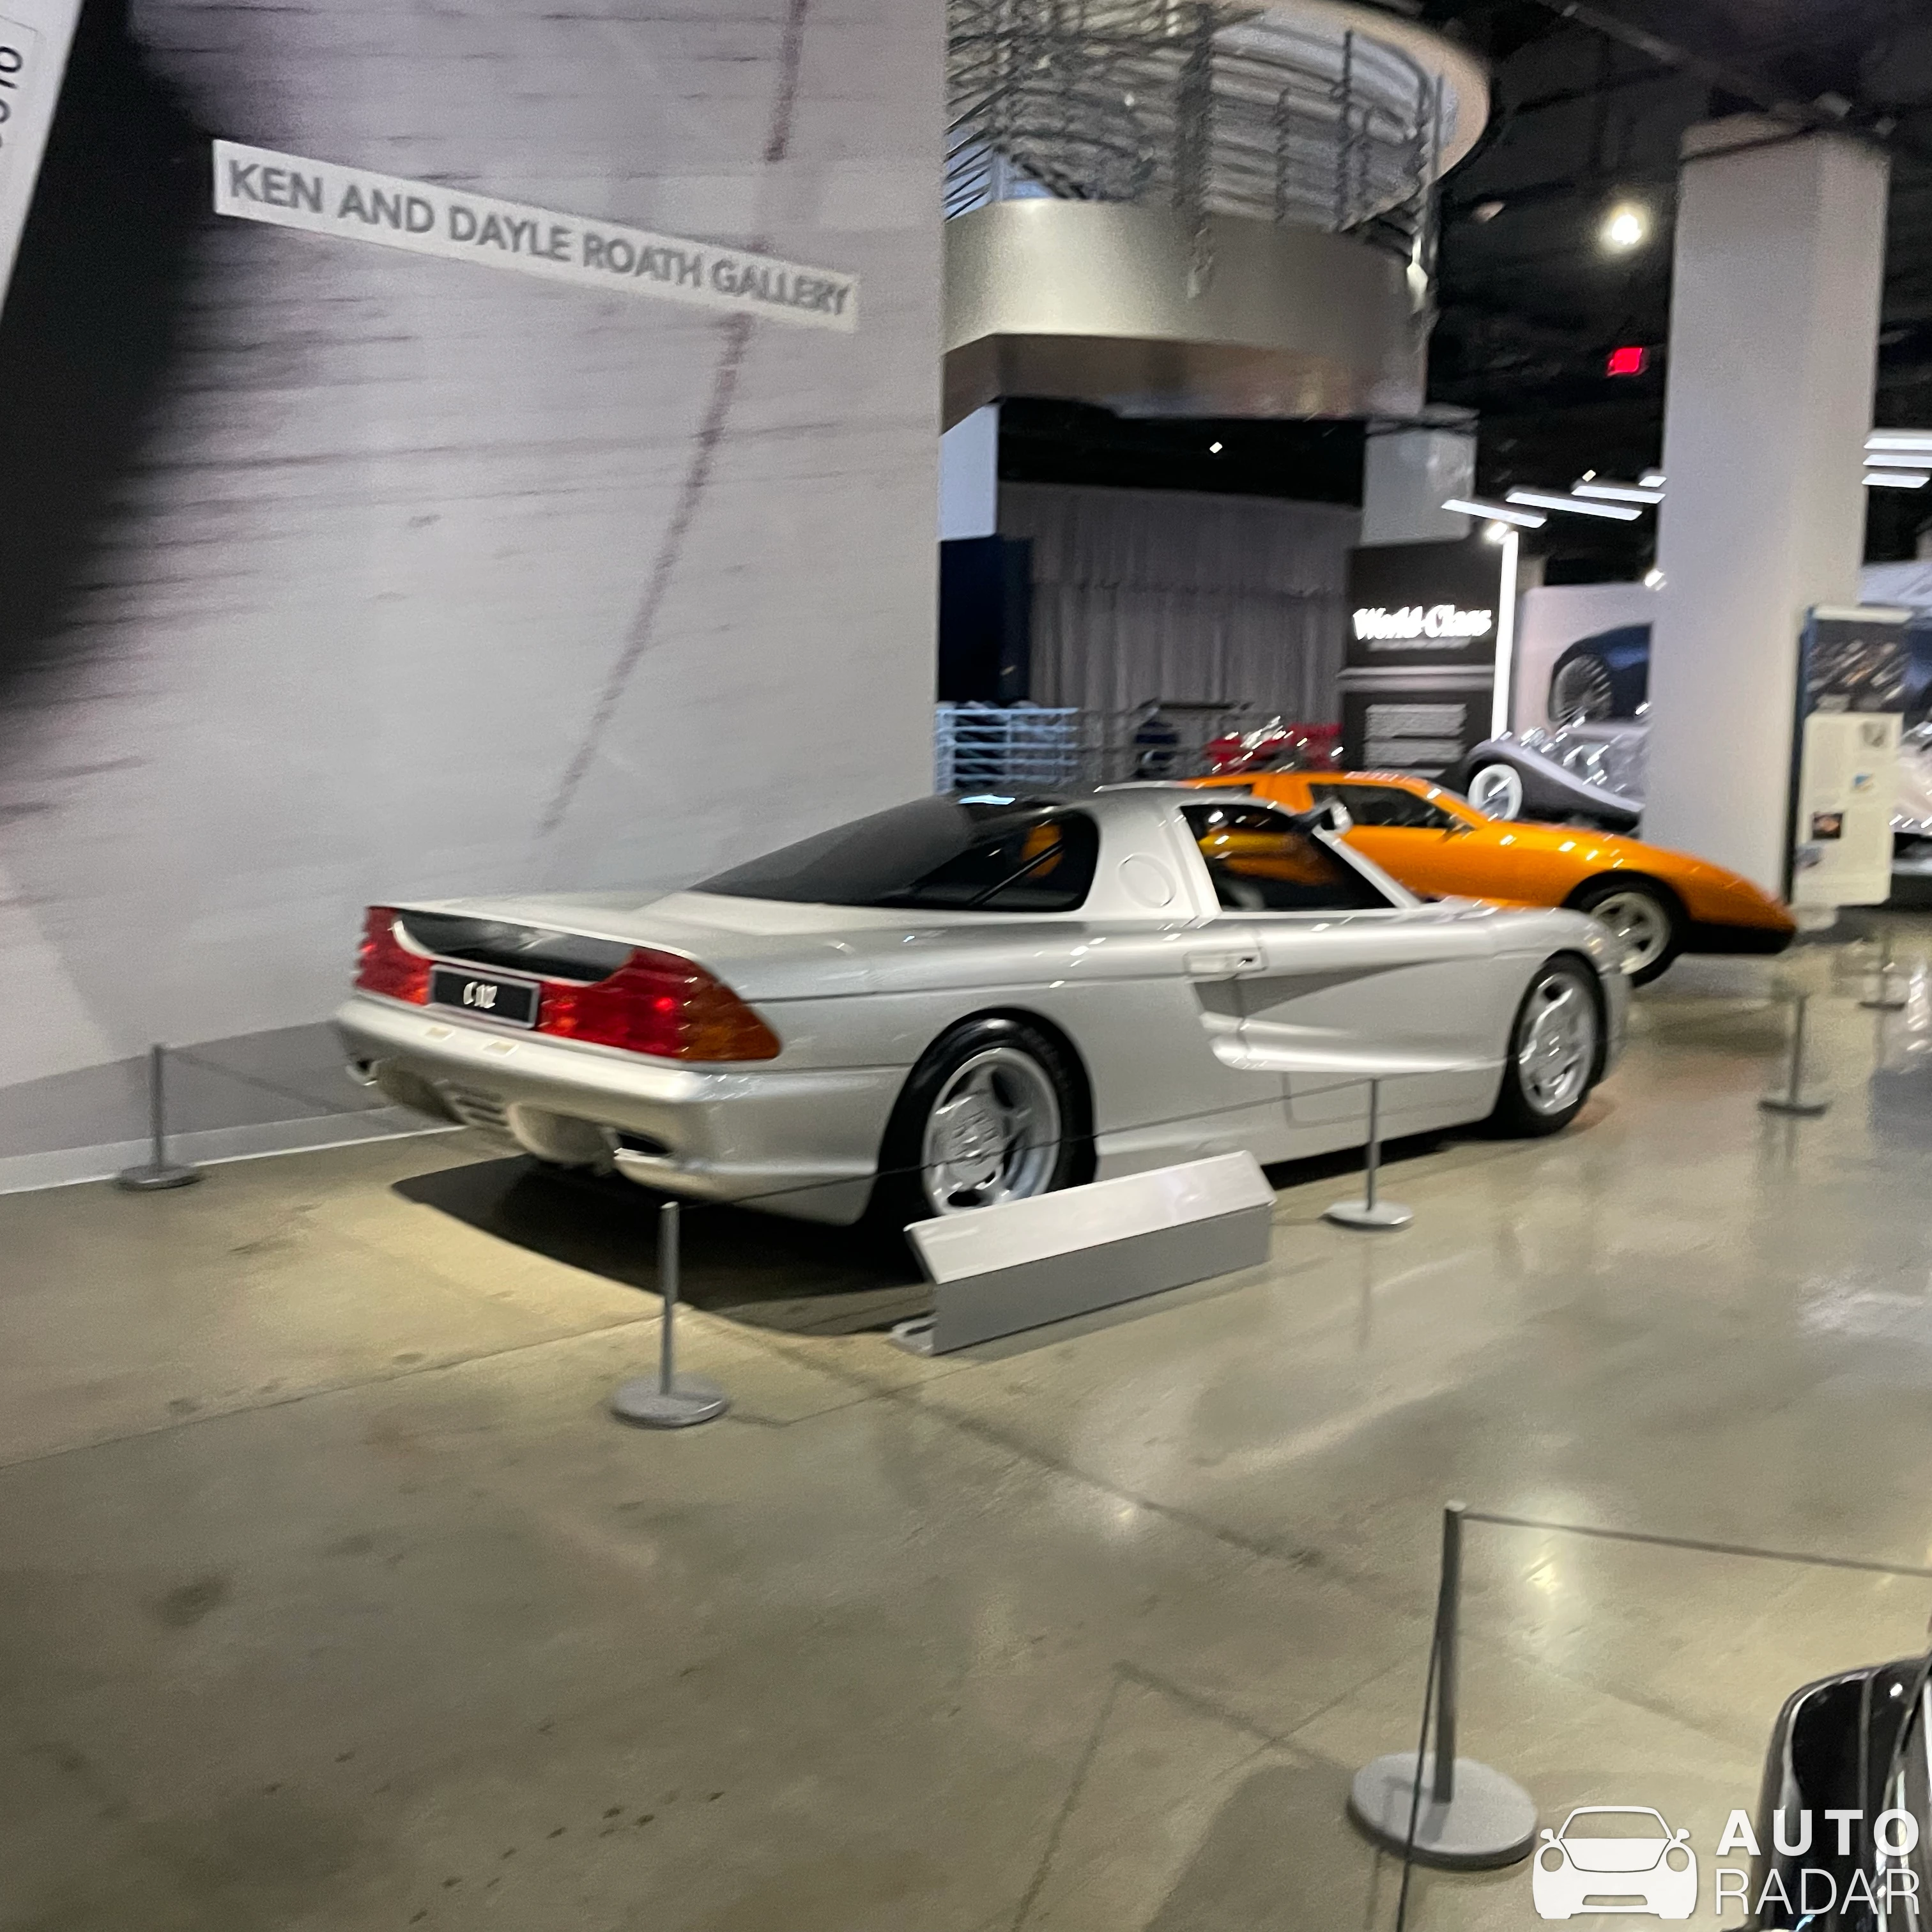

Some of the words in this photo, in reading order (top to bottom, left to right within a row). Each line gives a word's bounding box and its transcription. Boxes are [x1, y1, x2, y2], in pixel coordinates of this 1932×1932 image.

[228, 158, 324, 213] KEN
[337, 185, 436, 234] AND
[448, 206, 572, 262] DAYLE
[583, 233, 702, 288] ROATH
[710, 258, 851, 315] GALLERY
